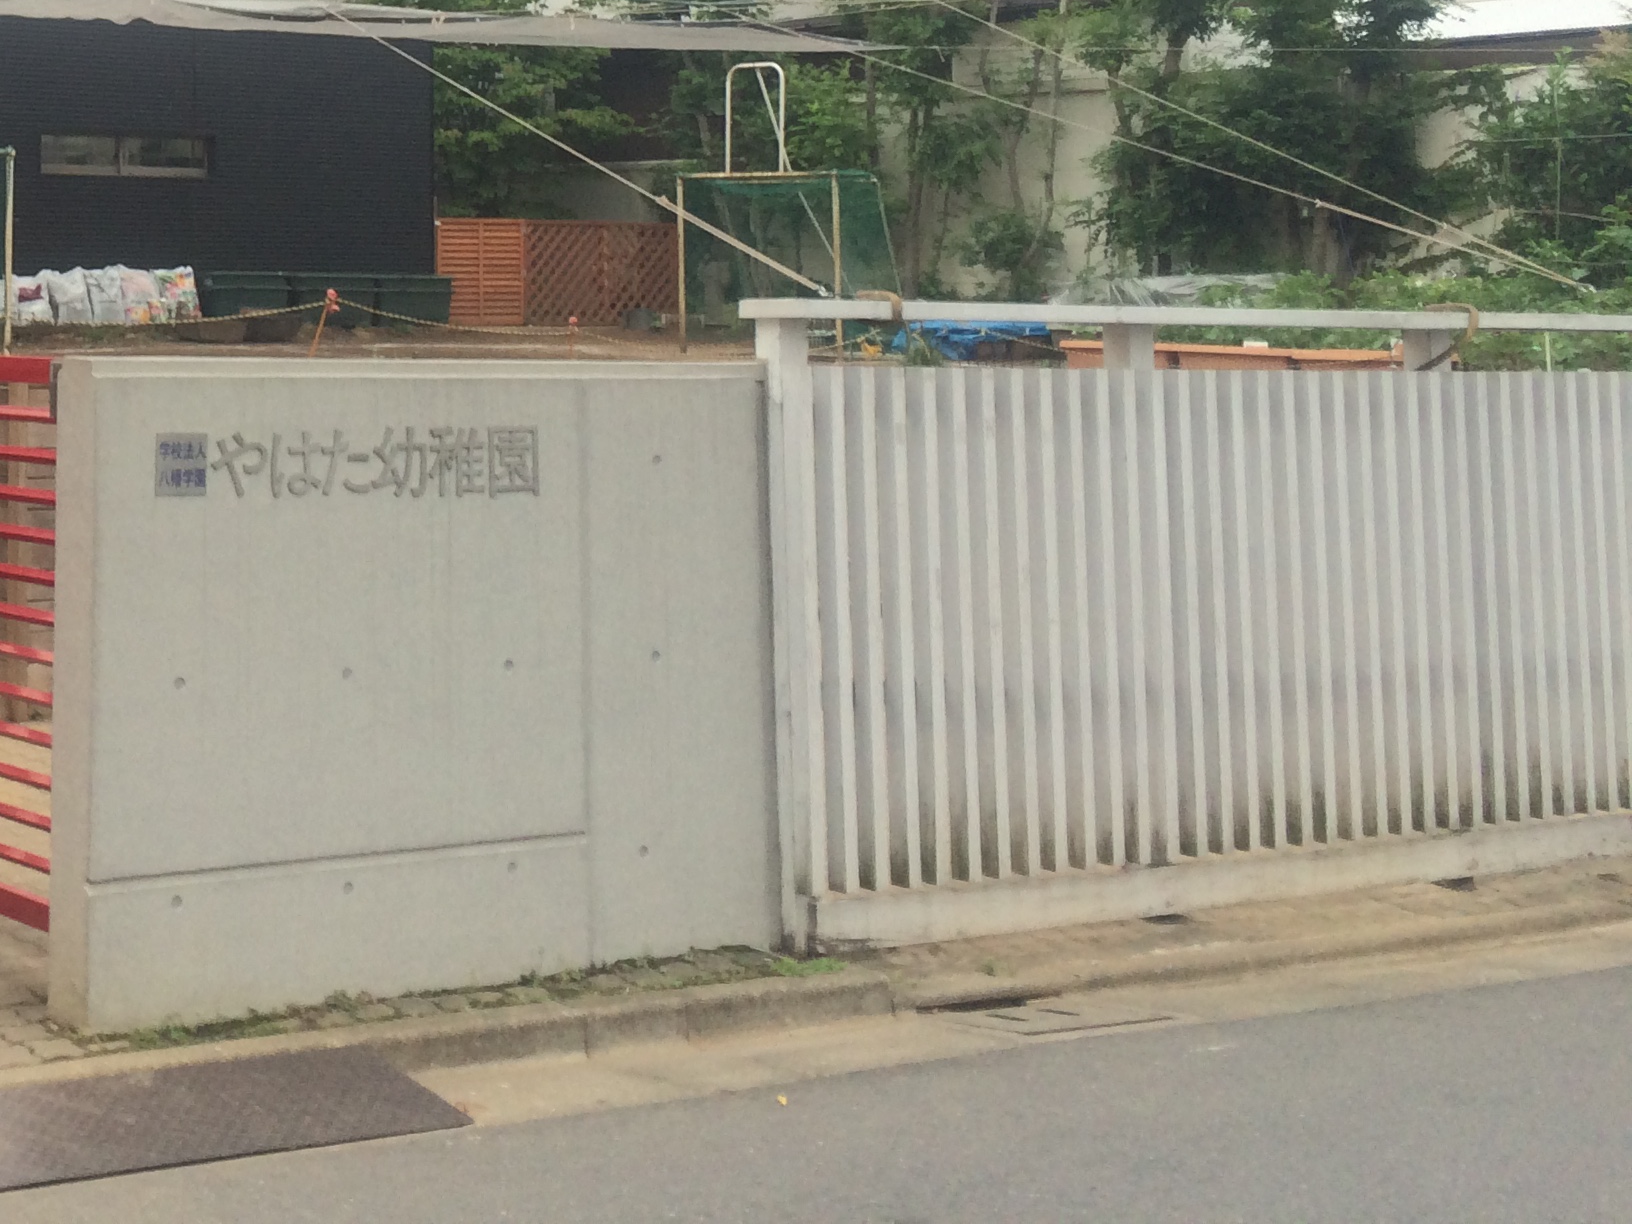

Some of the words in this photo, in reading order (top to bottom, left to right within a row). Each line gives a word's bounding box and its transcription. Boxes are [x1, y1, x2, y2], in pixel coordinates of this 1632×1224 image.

[210, 424, 539, 499] やはた幼稚園
